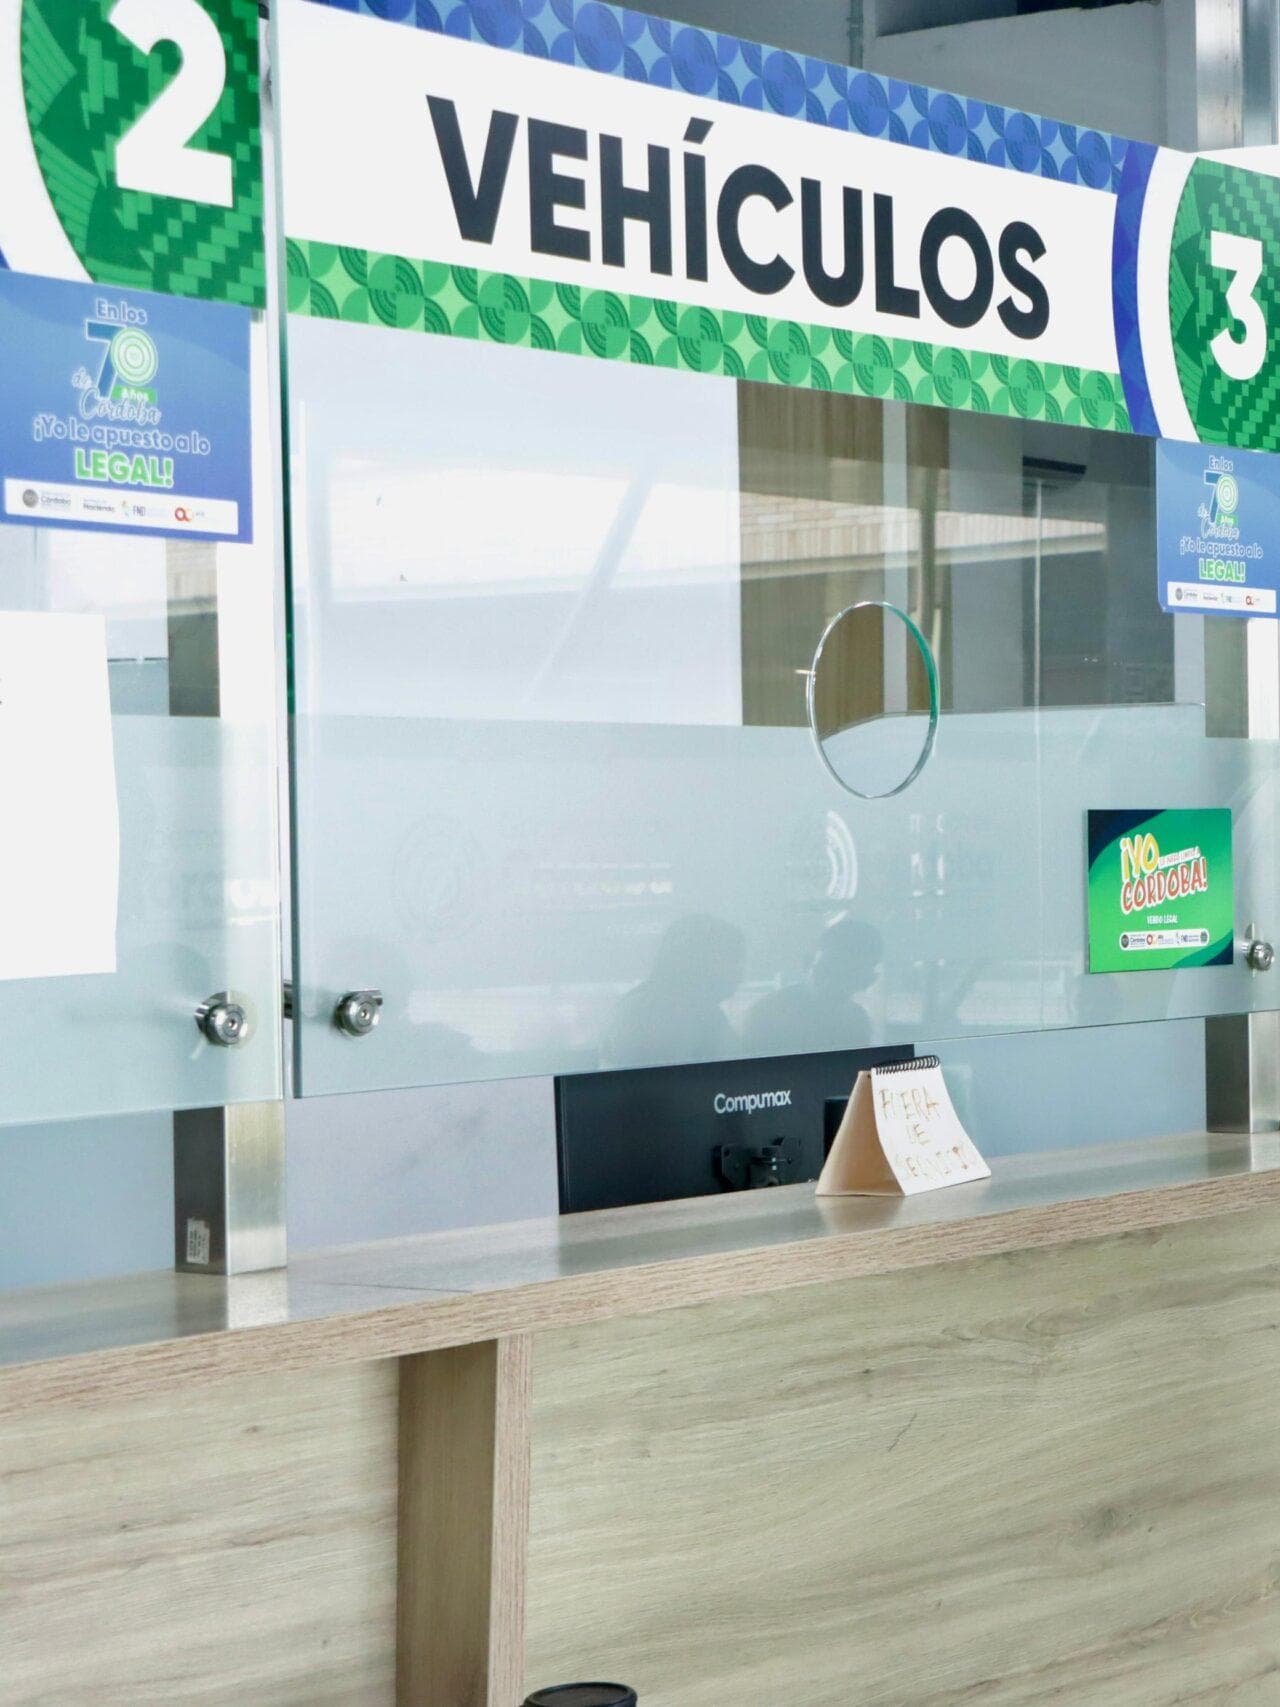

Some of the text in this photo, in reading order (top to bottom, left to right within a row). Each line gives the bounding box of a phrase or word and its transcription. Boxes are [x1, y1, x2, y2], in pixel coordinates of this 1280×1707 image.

[107, 0, 234, 208] 2
[426, 95, 1268, 381] VEHÍCULOS 3
[96, 298, 148, 325] En los
[33, 414, 211, 455] ¡Yo le apuesto a lo
[75, 448, 174, 489] LEGAL!
[1208, 541, 1245, 558] apuesto
[1199, 557, 1246, 583] LEGAL!
[714, 1090, 792, 1114] Compumax
